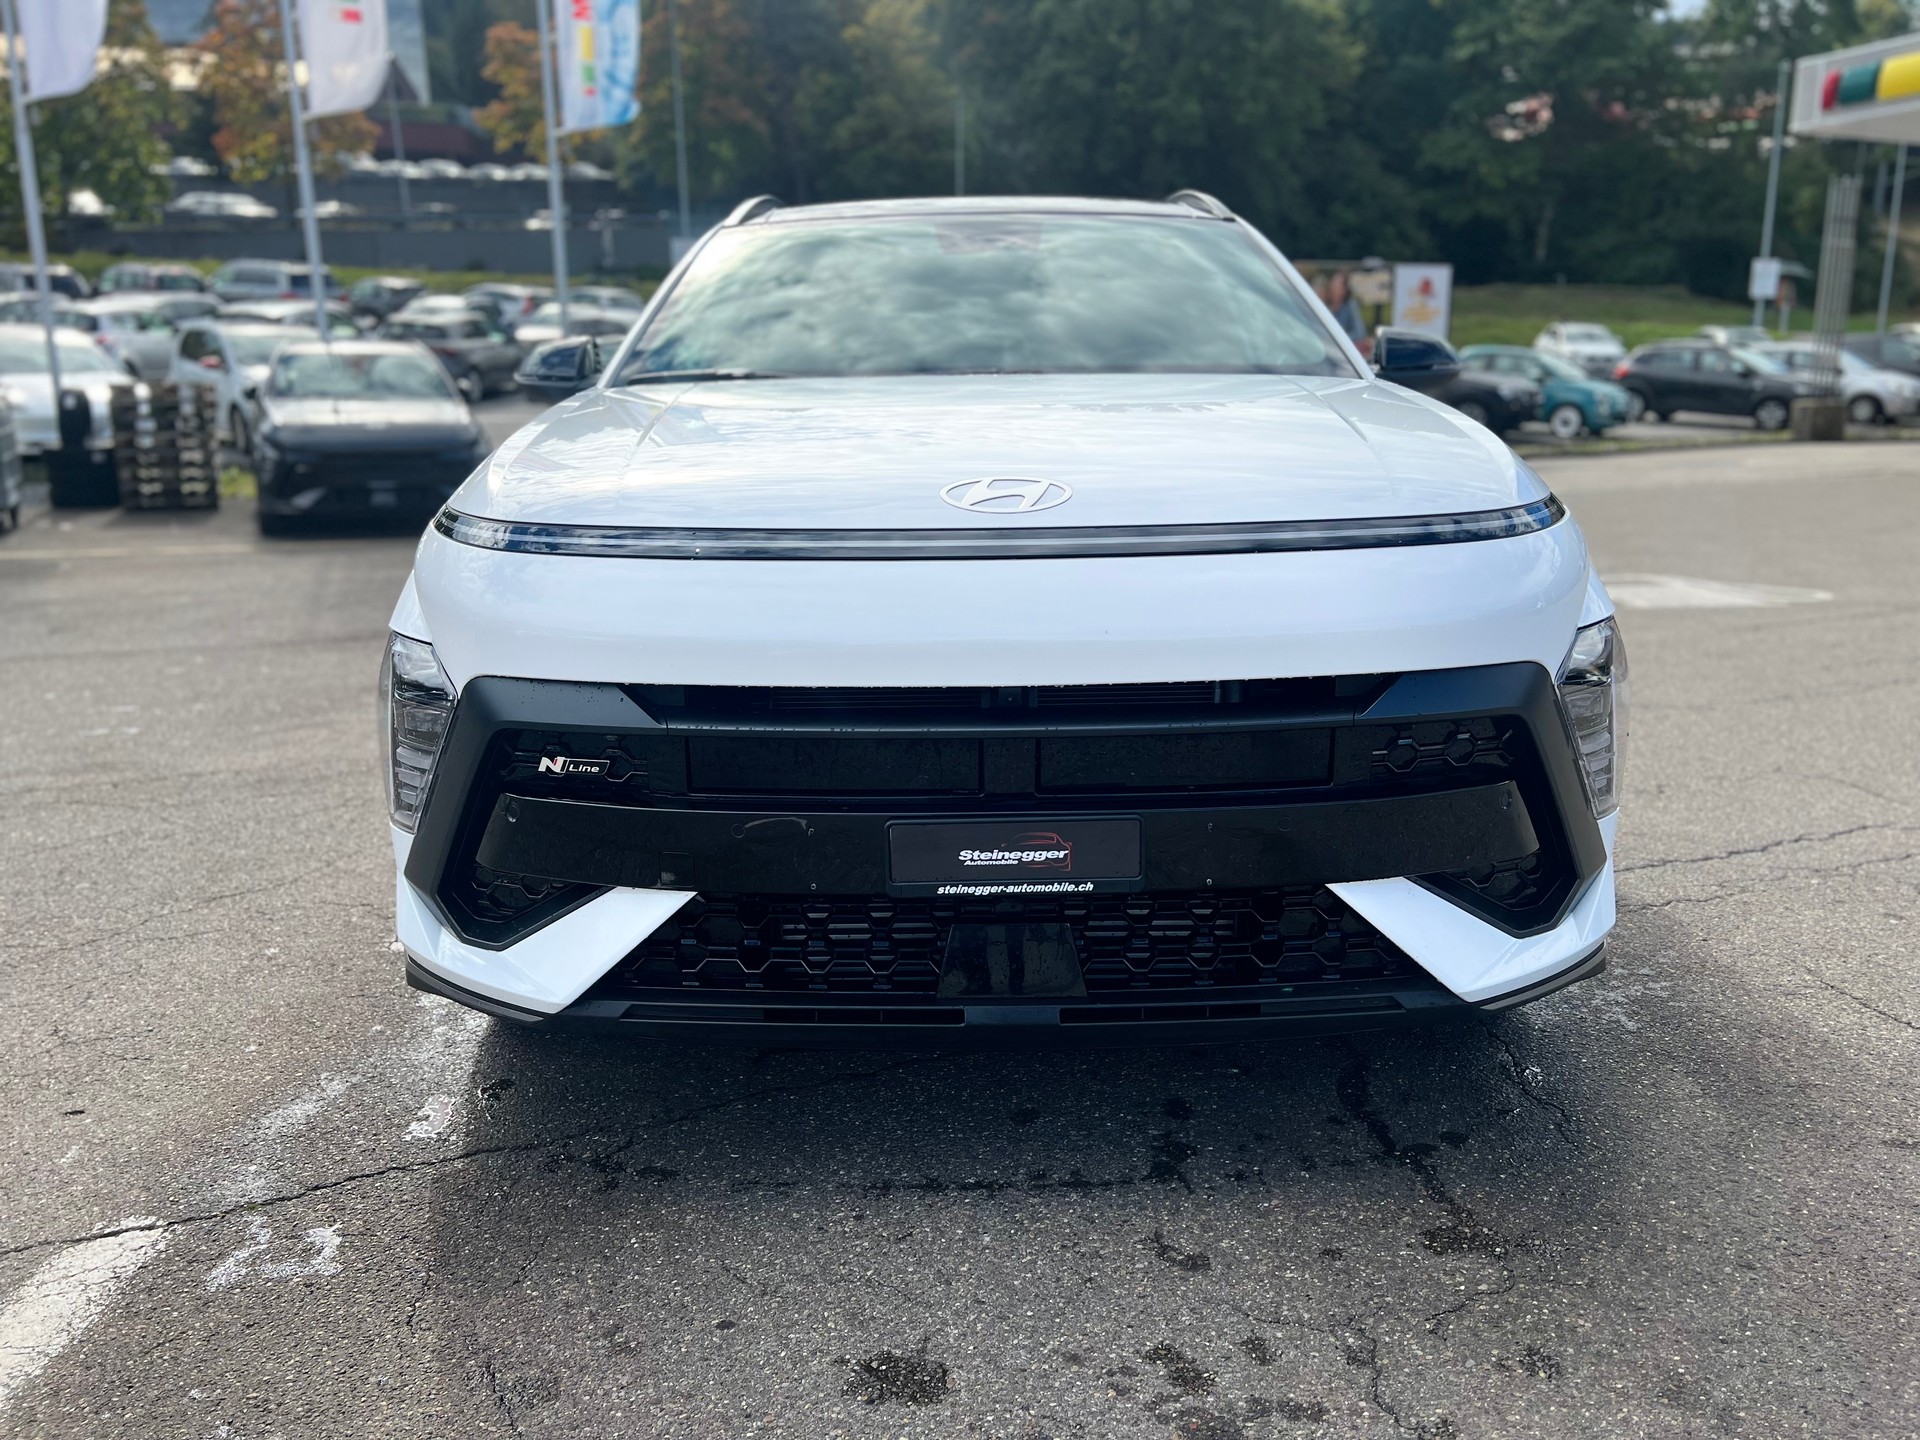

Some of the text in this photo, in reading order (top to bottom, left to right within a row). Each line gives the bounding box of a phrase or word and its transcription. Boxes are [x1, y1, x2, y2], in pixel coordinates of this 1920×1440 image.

[569, 764, 600, 773] Line
[958, 849, 1069, 862] Steinegger
[937, 882, 1094, 896] steinegger-automobile.ch
